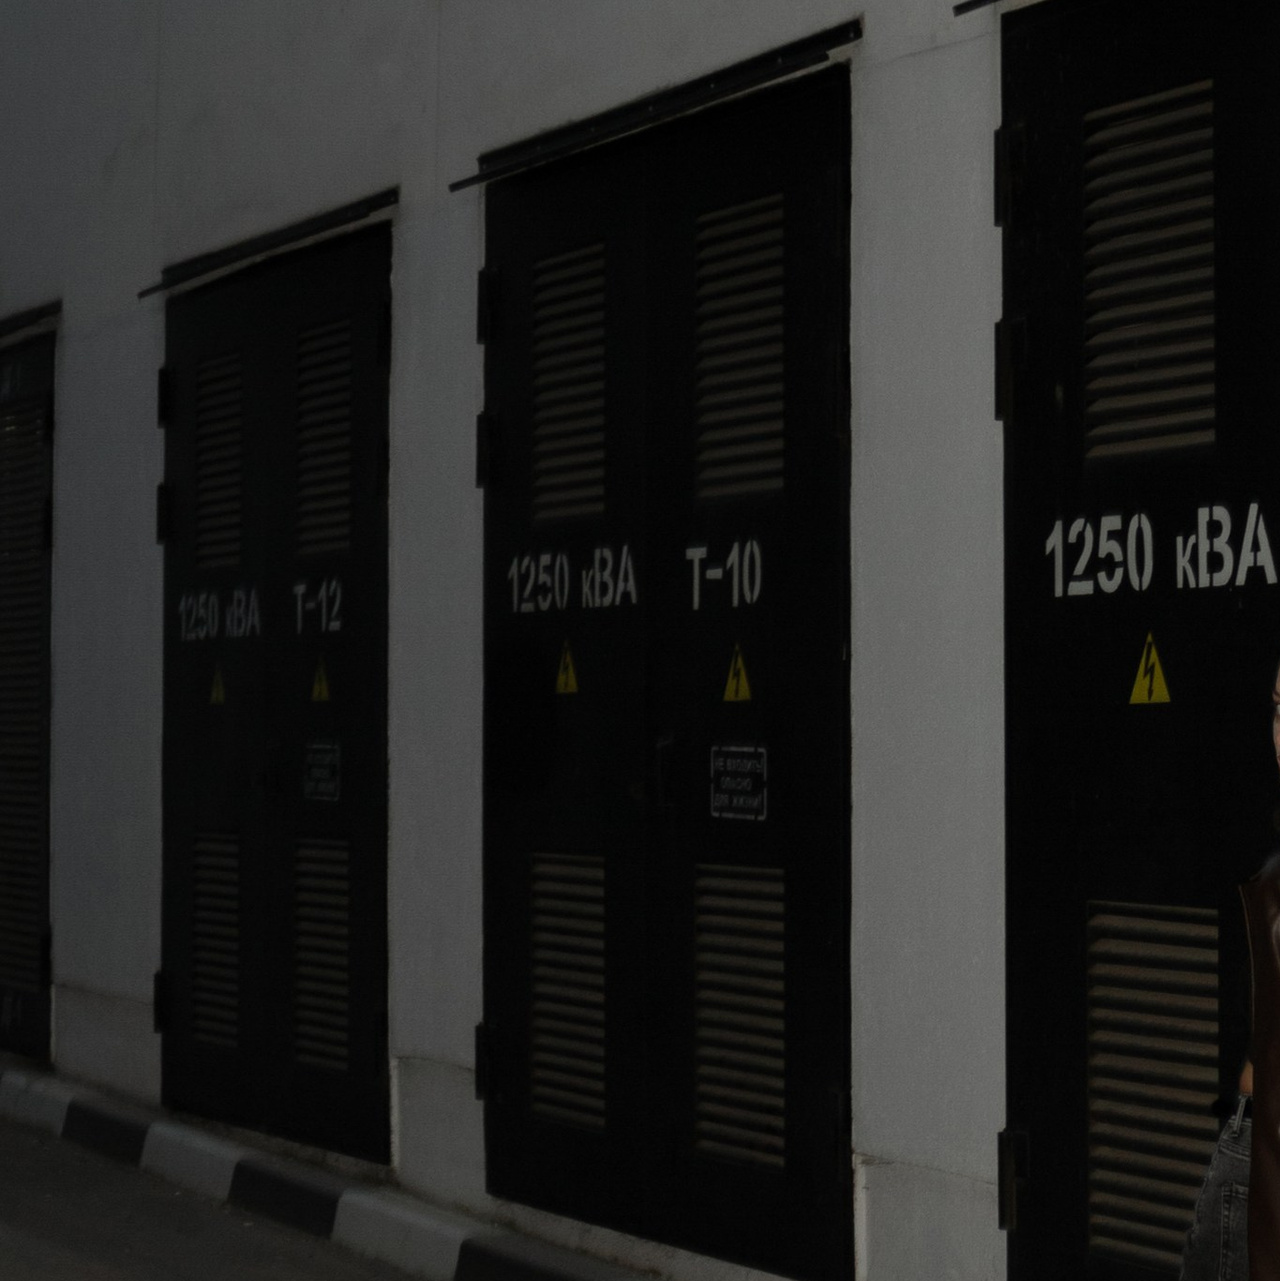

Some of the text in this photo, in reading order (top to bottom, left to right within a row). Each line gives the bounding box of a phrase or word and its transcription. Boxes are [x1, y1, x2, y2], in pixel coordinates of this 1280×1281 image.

[507, 544, 638, 613] 1250 кВА
[685, 539, 762, 611] Т-10
[1044, 502, 1279, 598] 1250 кВА
[178, 591, 220, 642] 1250
[292, 577, 343, 636] Т-12
